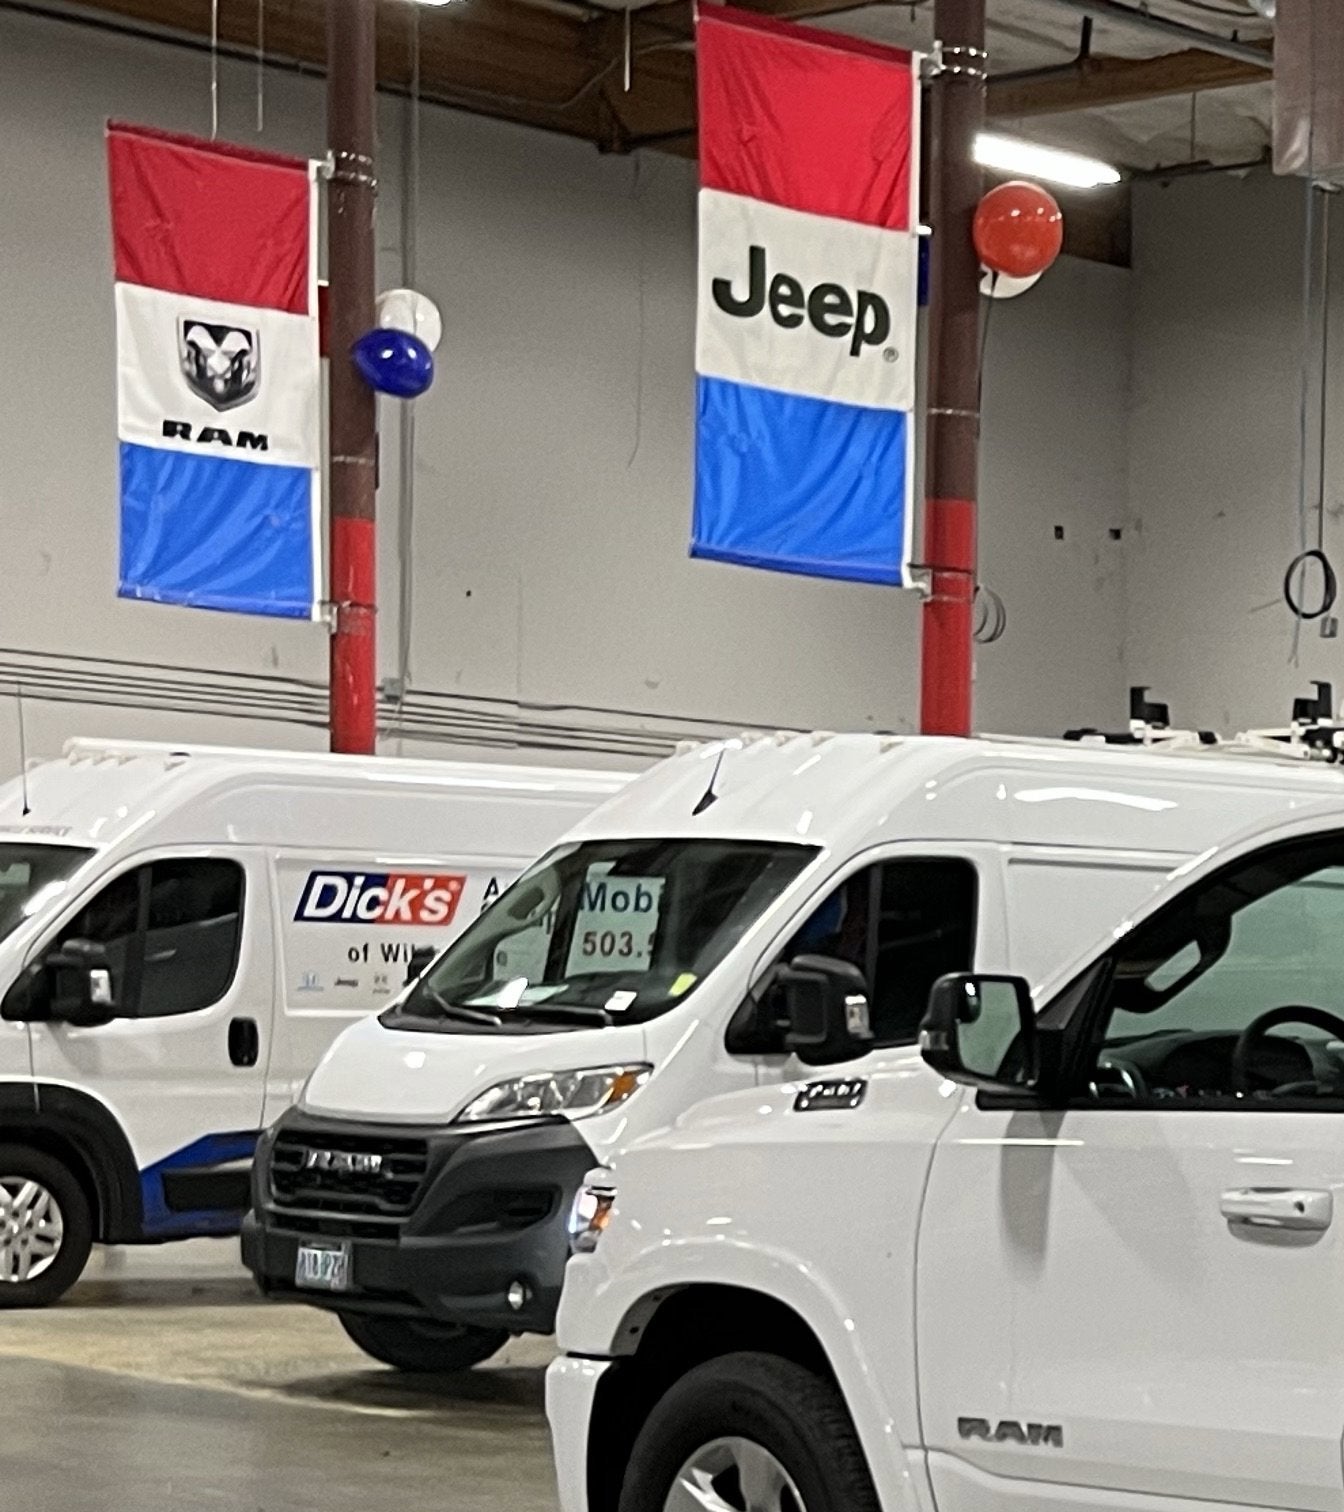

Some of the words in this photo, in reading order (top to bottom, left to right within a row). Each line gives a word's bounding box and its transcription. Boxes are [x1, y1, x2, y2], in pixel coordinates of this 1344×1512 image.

[712, 245, 891, 357] Jeep
[162, 419, 268, 451] RAM
[302, 875, 452, 923] Dick's
[580, 881, 653, 912] Mob
[347, 943, 369, 963] of
[957, 1416, 1063, 1449] RAM
